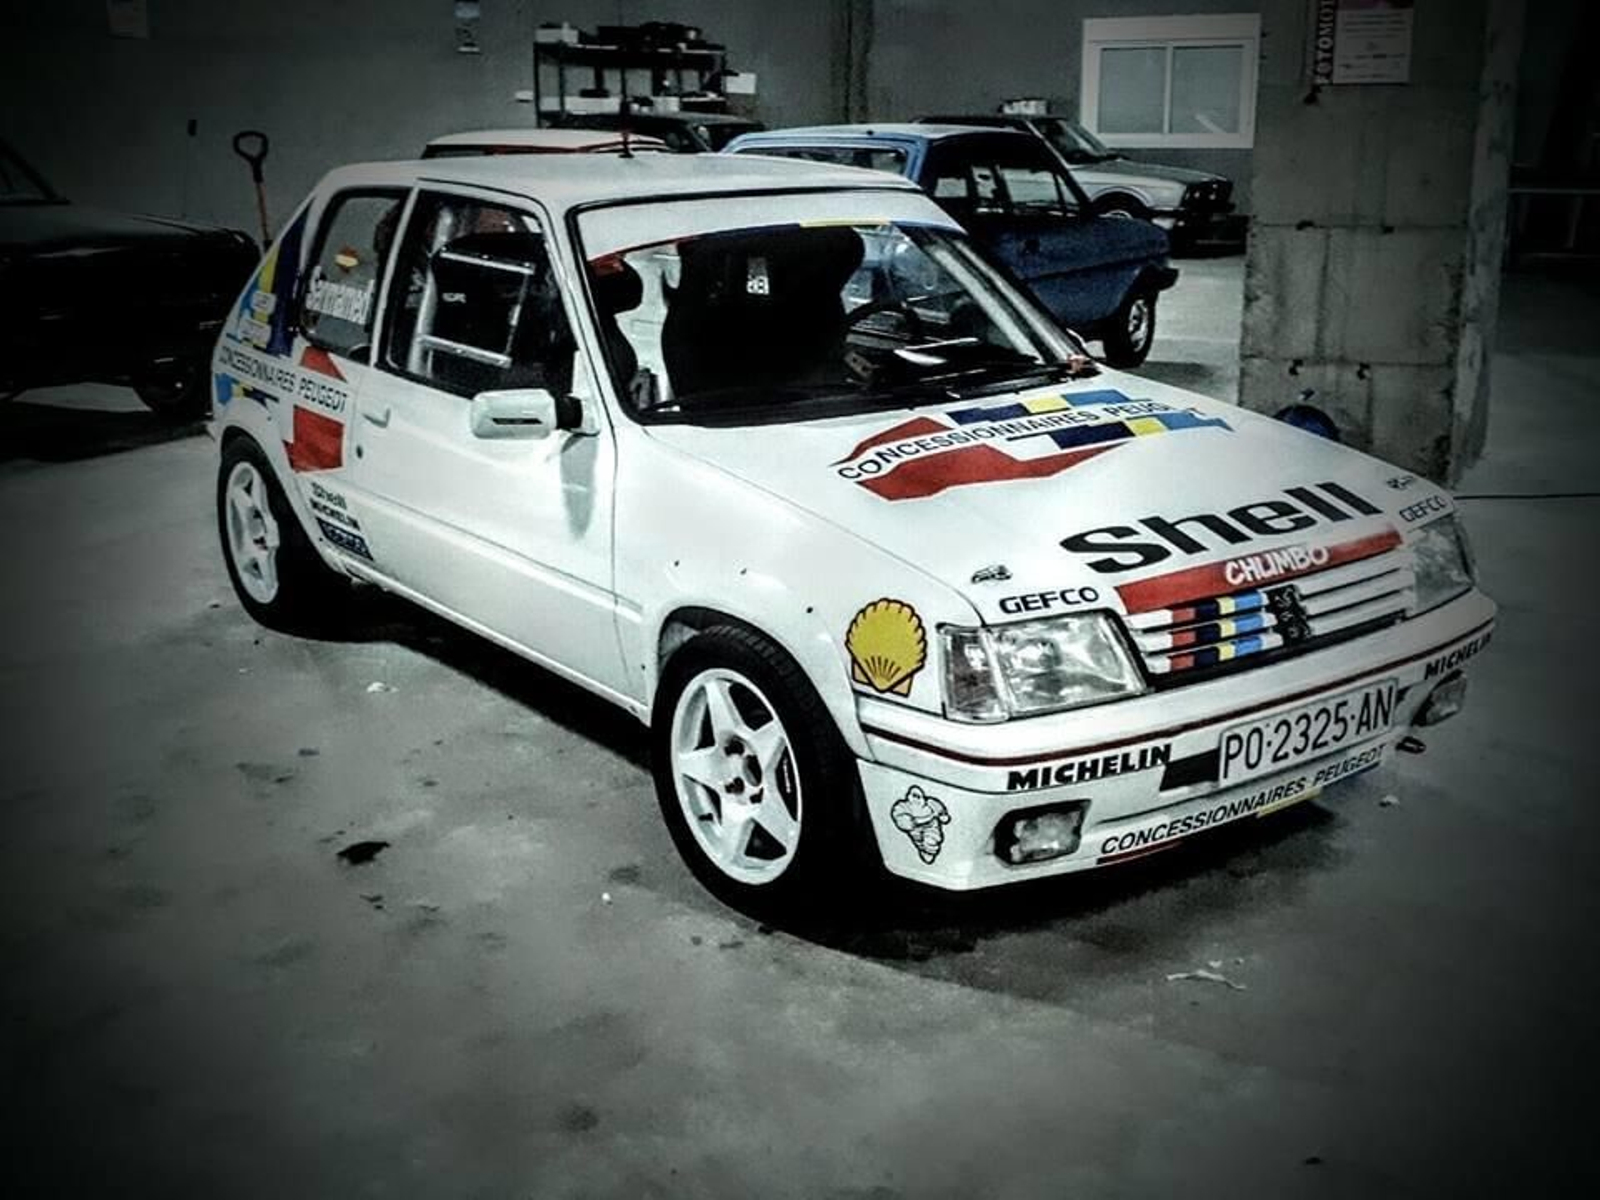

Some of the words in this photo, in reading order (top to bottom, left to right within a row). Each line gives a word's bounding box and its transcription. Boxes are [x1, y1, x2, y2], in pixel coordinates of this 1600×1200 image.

[838, 409, 1099, 482] CONCESSIONNAIRES
[1060, 482, 1382, 573] Shell
[1225, 545, 1331, 586] CHUMBO
[999, 586, 1099, 614] GEFCO
[1007, 743, 1172, 791] MICHELIN
[1101, 776, 1313, 855] CONCESSIONNAIRES
[1313, 744, 1387, 786] PEUGEOT
